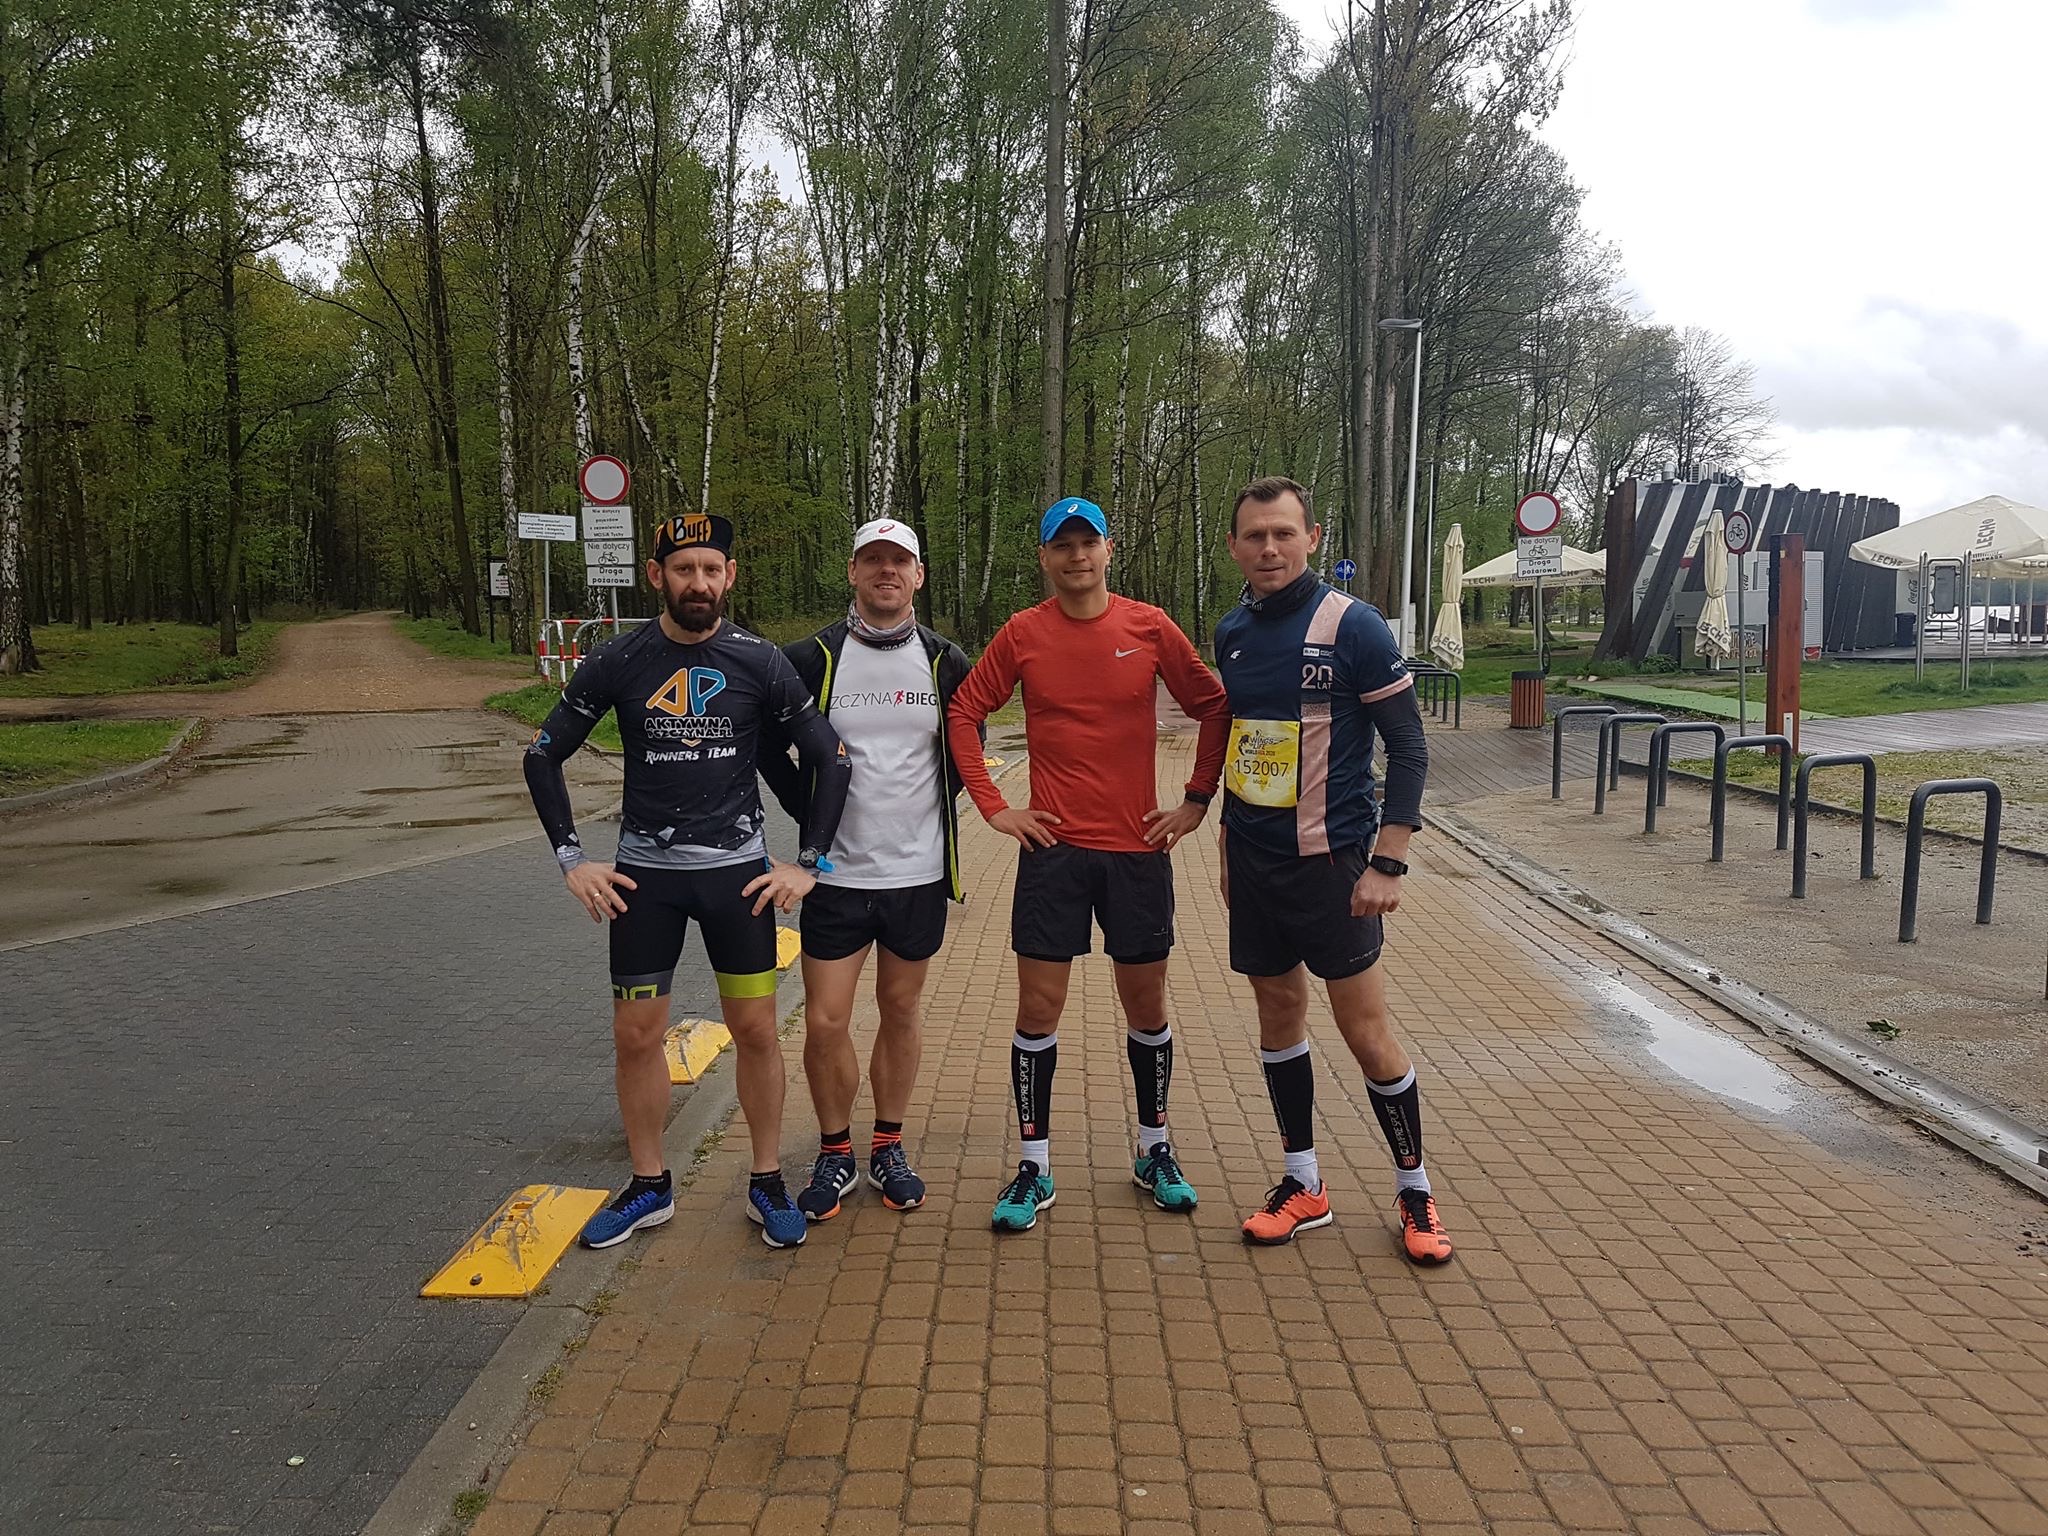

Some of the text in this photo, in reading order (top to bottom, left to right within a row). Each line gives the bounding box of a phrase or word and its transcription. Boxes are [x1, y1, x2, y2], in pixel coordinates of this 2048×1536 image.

[1534, 537, 1560, 545] dotyczy
[587, 542, 631, 551] Nie dotyczy
[1529, 559, 1551, 567] Droga
[2023, 560, 2048, 569] LEC
[600, 566, 623, 576] Droga
[1521, 567, 1557, 576] pożarowa
[592, 577, 631, 585] pożarowa
[1468, 577, 1491, 585] LECH
[830, 691, 938, 710] ZCZYNA BIEG
[644, 717, 733, 730] AKTYWNA
[644, 746, 737, 765] RUNNERS TEAM
[1234, 759, 1289, 777] 152007
